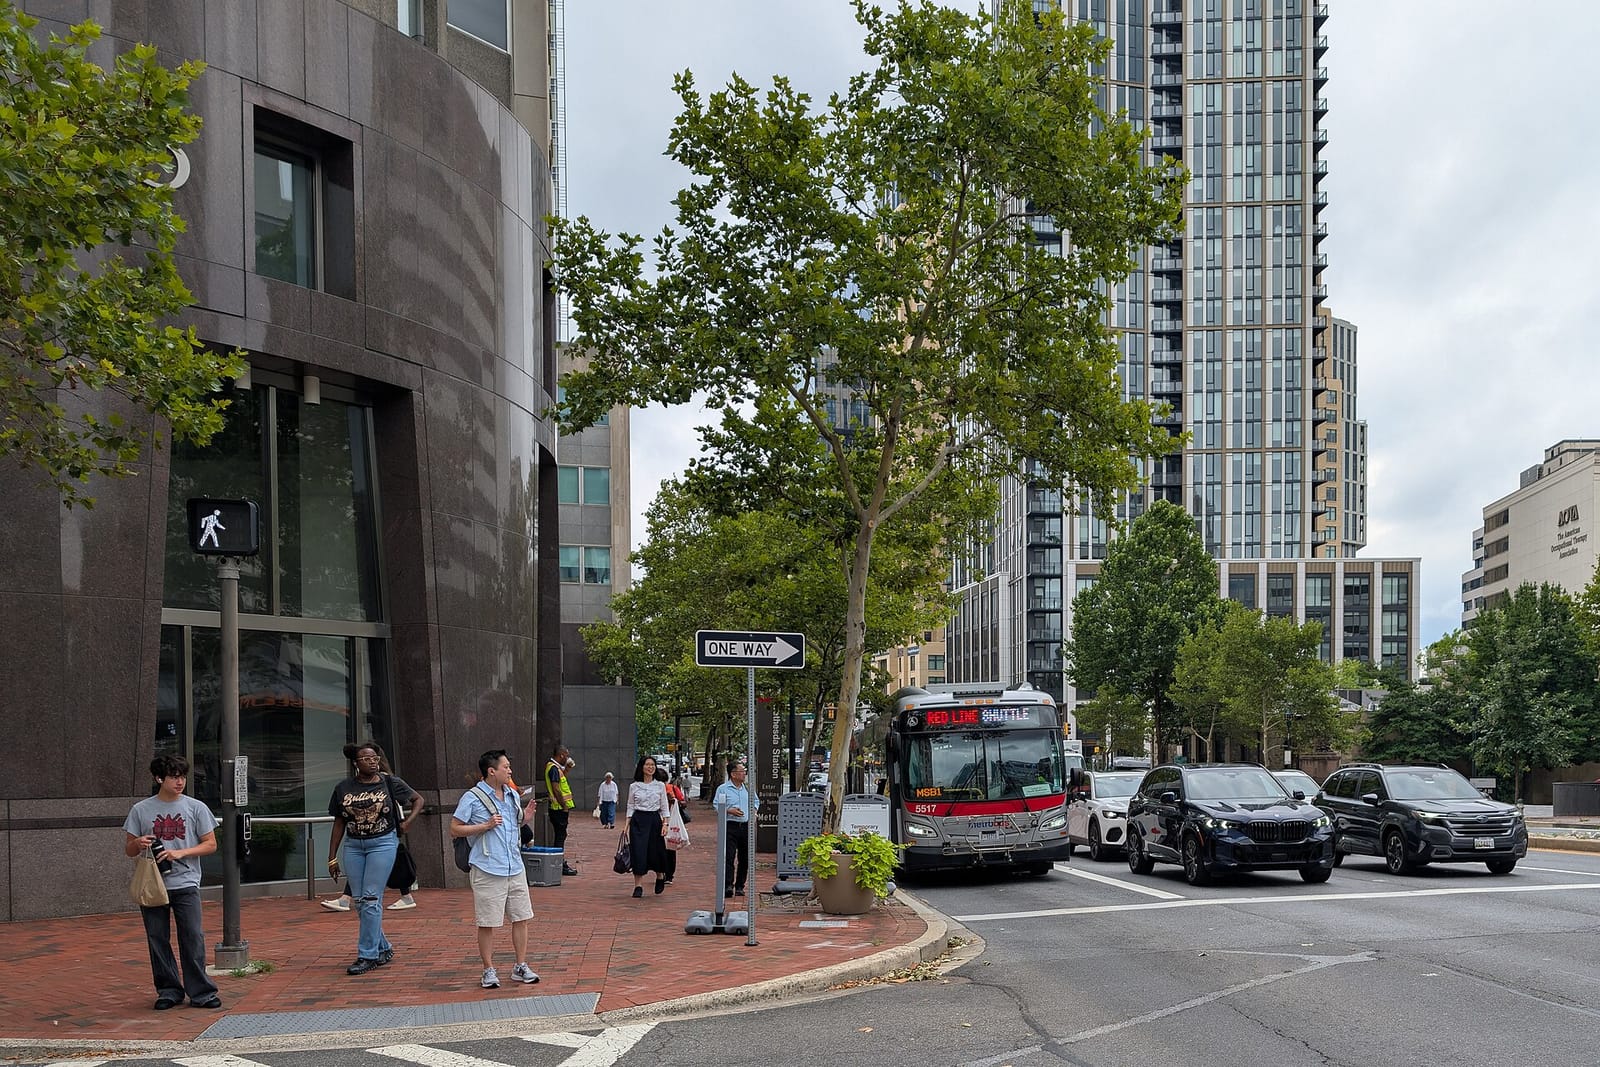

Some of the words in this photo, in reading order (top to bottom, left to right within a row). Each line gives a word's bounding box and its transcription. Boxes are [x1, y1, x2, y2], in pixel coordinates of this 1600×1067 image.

[709, 641, 738, 656] ONE
[743, 643, 773, 656] WAY
[927, 711, 949, 725] RED
[951, 709, 978, 724] LINE
[981, 707, 1030, 722] SHUTTLE
[772, 748, 781, 779] Station
[342, 791, 387, 806] Butterfly
[916, 787, 943, 798] MSB1
[915, 804, 937, 813] 5517
